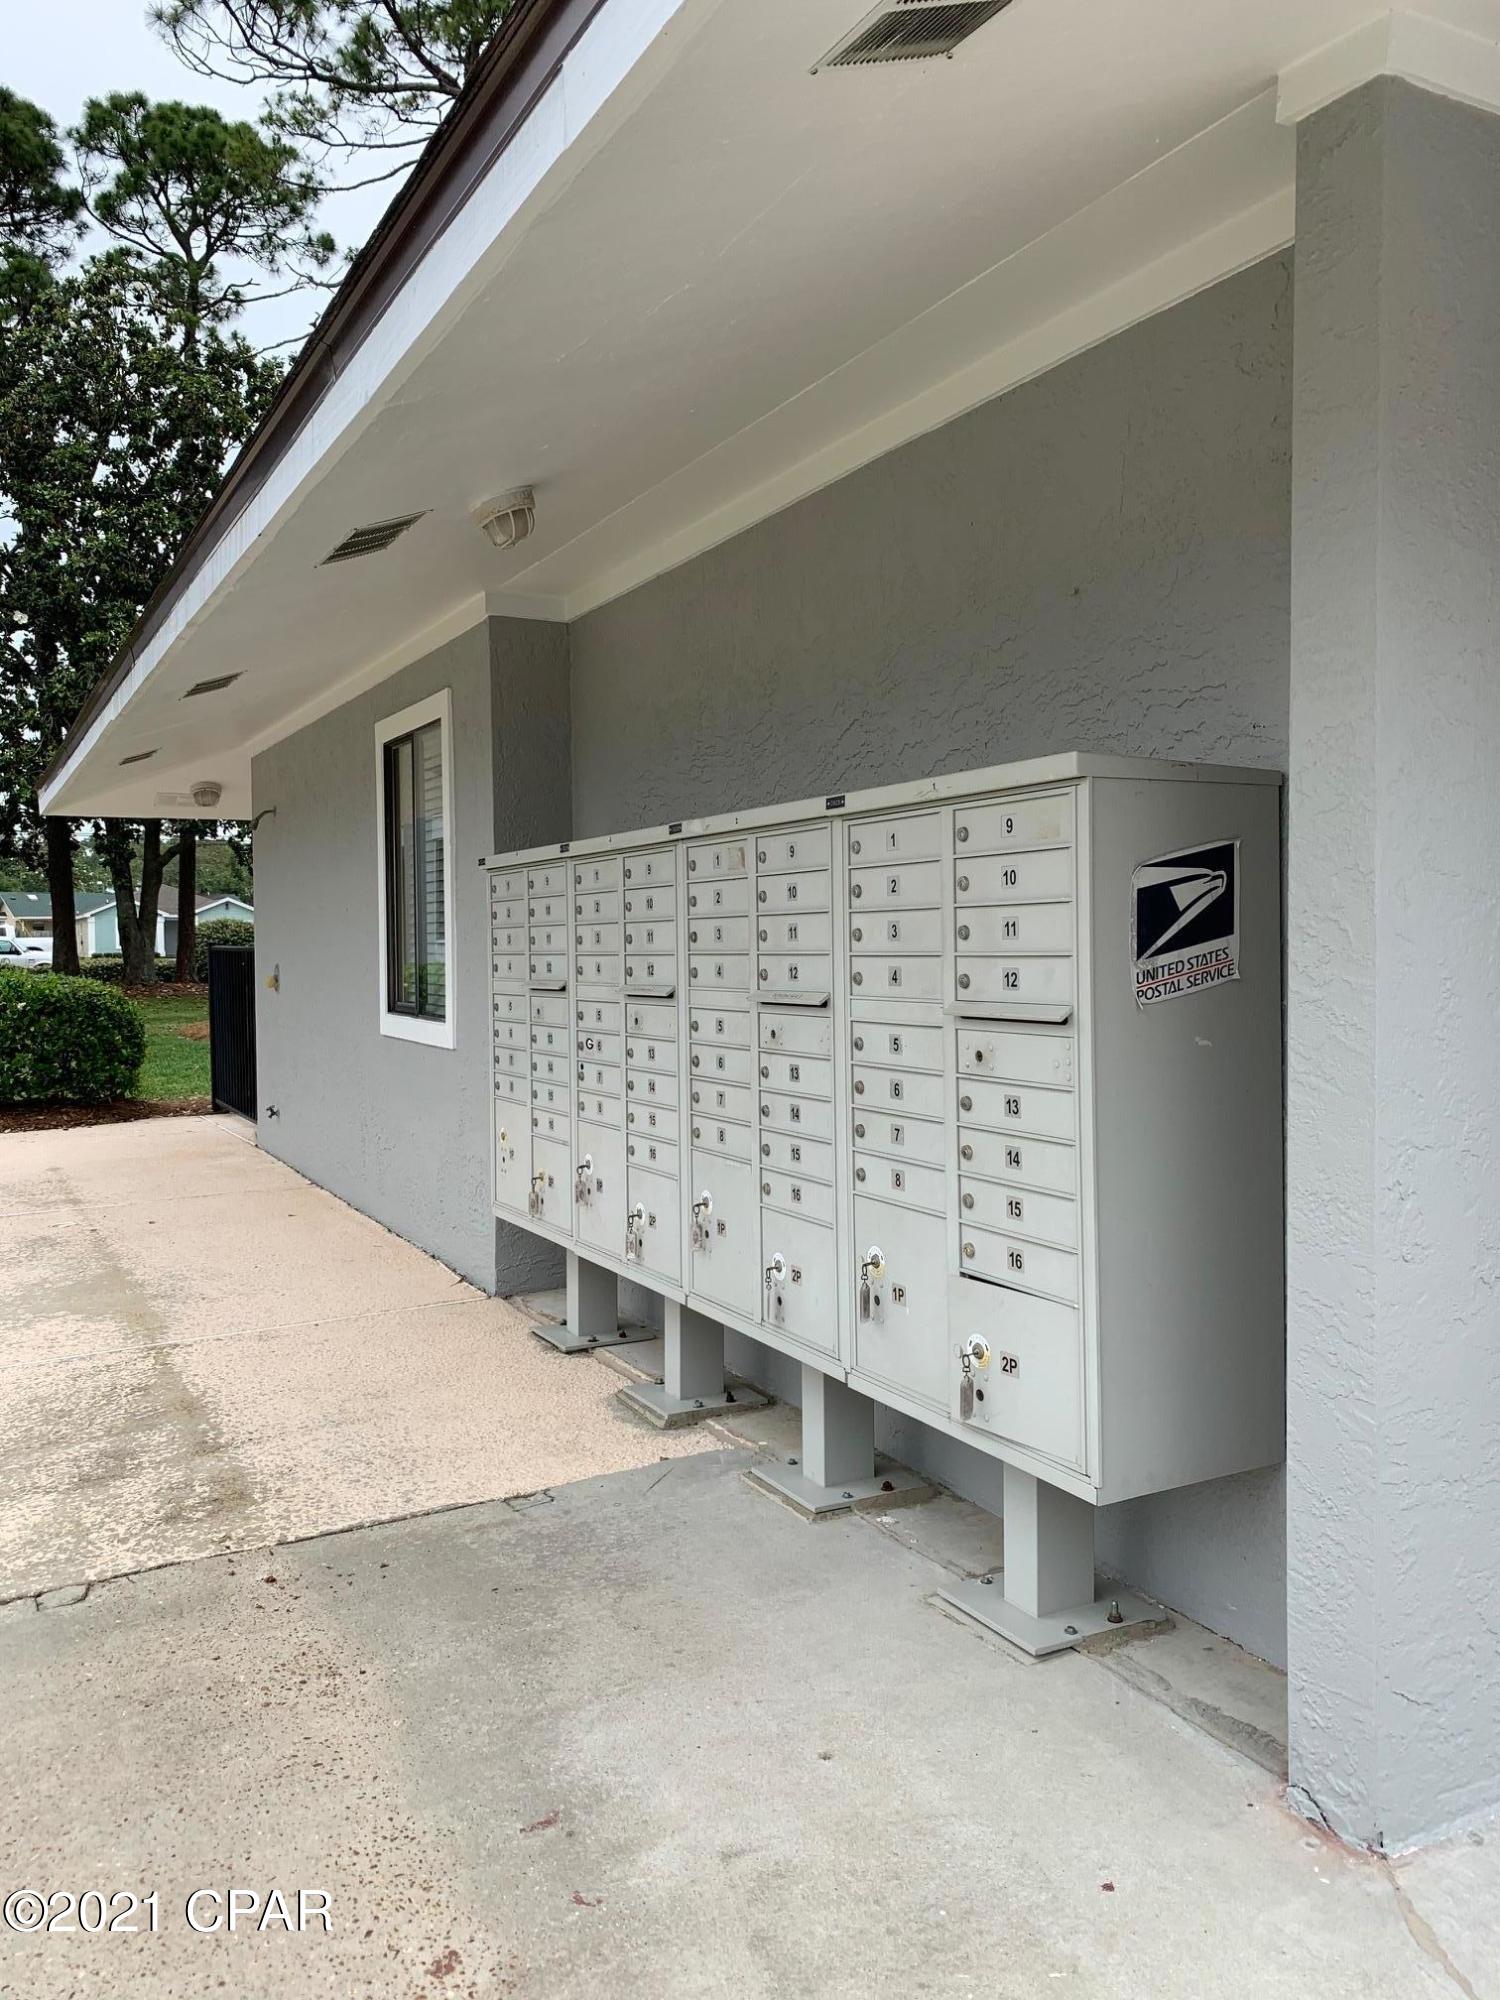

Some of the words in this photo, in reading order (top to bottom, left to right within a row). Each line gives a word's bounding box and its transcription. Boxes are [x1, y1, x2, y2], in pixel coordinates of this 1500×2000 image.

[1006, 818, 1013, 833] 9
[890, 833, 896, 847] 1
[1003, 870, 1016, 885] 10
[788, 886, 797, 898] 10
[891, 880, 897, 893] 2
[789, 927, 797, 939] 11
[891, 925, 897, 938] 3
[1004, 921, 1016, 936] 11
[1136, 960, 1184, 984] UNITED
[1188, 946, 1230, 971] STATES
[789, 967, 798, 979] 12
[892, 970, 898, 983] 4
[1004, 972, 1018, 987] 12
[1136, 980, 1184, 1000] POSTAL
[1186, 963, 1235, 989] SERVICE
[586, 1038, 594, 1050] G
[893, 1038, 899, 1051] 5
[790, 1067, 799, 1080] 13
[894, 1083, 900, 1096] 6
[1006, 1099, 1019, 1114] 13
[791, 1107, 799, 1120] 14
[895, 1128, 900, 1142] 7
[792, 1148, 800, 1160] 15
[1007, 1150, 1020, 1166] 14
[895, 1174, 901, 1187] 8
[792, 1188, 801, 1201] 16
[1008, 1201, 1021, 1217] 15
[718, 1222, 725, 1234] 1P
[1009, 1252, 1022, 1269] 16
[792, 1269, 801, 1282] 2P
[893, 1288, 904, 1302] 1P
[1002, 1356, 1017, 1373] 2P
